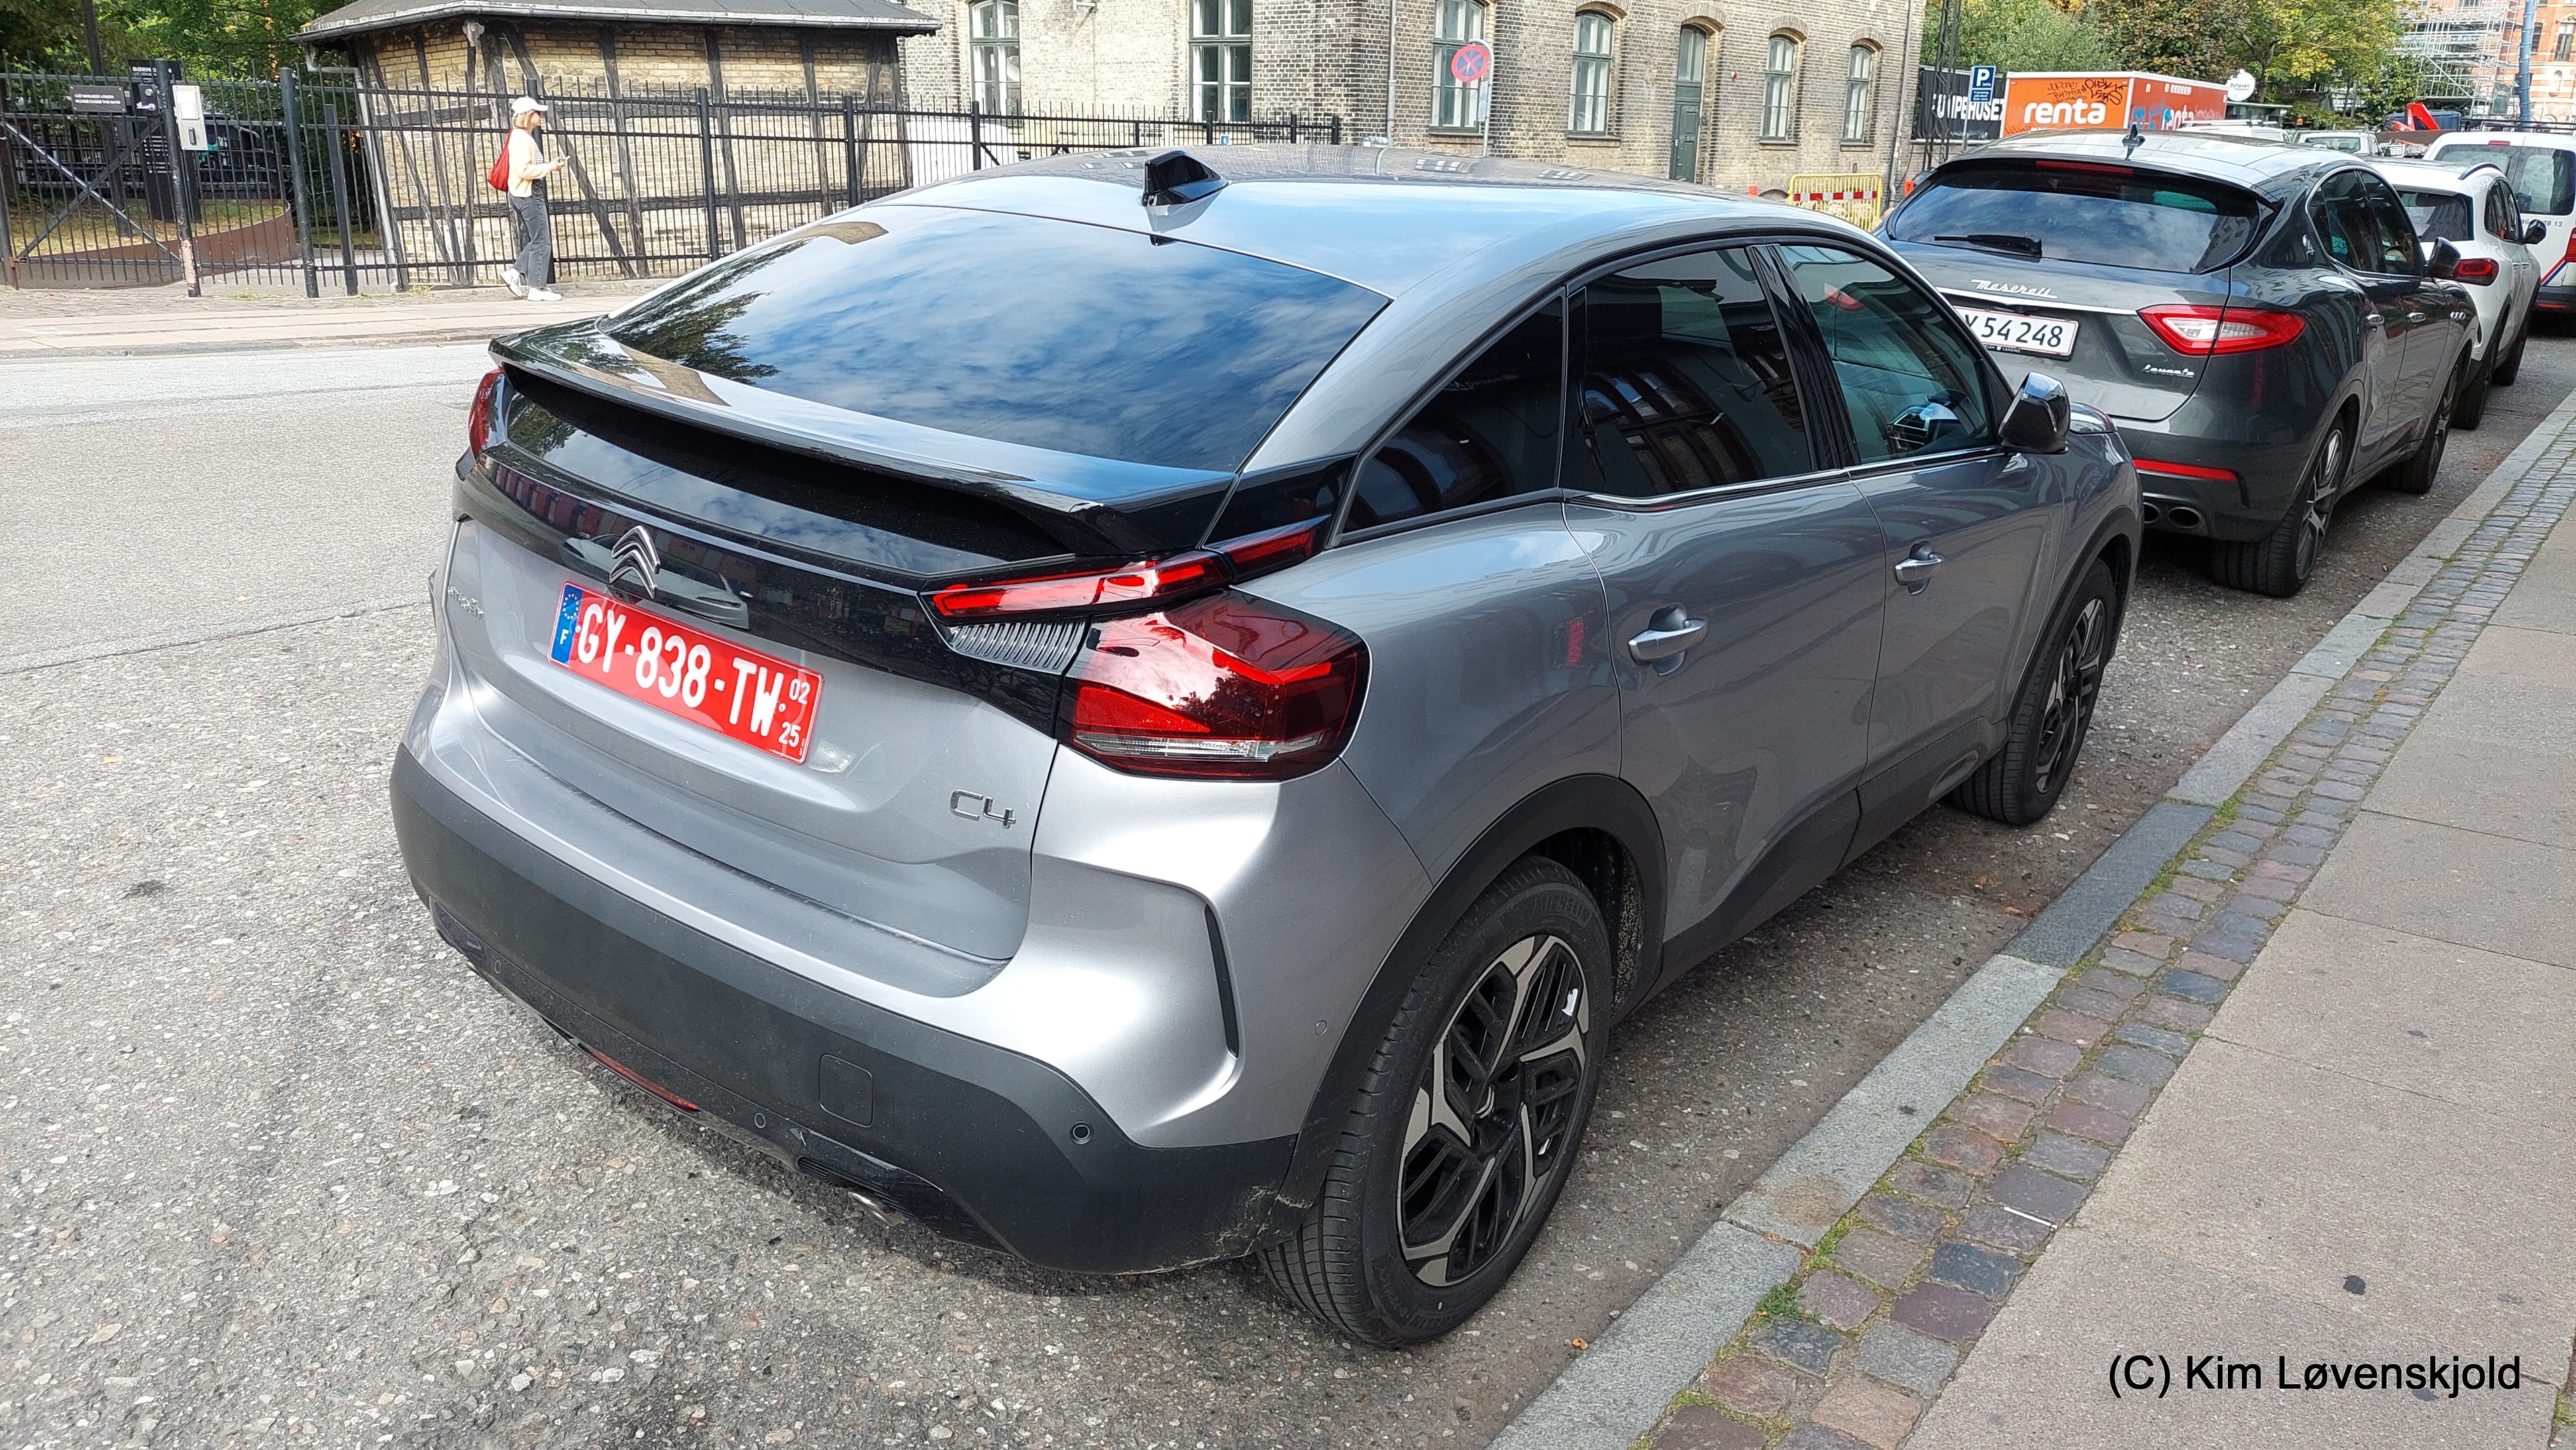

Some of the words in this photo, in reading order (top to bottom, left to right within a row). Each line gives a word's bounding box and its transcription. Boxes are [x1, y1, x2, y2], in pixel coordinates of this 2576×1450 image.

[1976, 68, 1990, 87] P
[2024, 98, 2106, 125] renta
[1970, 279, 2058, 299] Maserati
[1981, 317, 2013, 341] 54
[2015, 321, 2063, 347] 248
[559, 628, 570, 645] F
[578, 604, 784, 737] GY-838-TW
[789, 678, 811, 706] 02
[778, 721, 802, 748] 25
[949, 789, 1017, 829] C4
